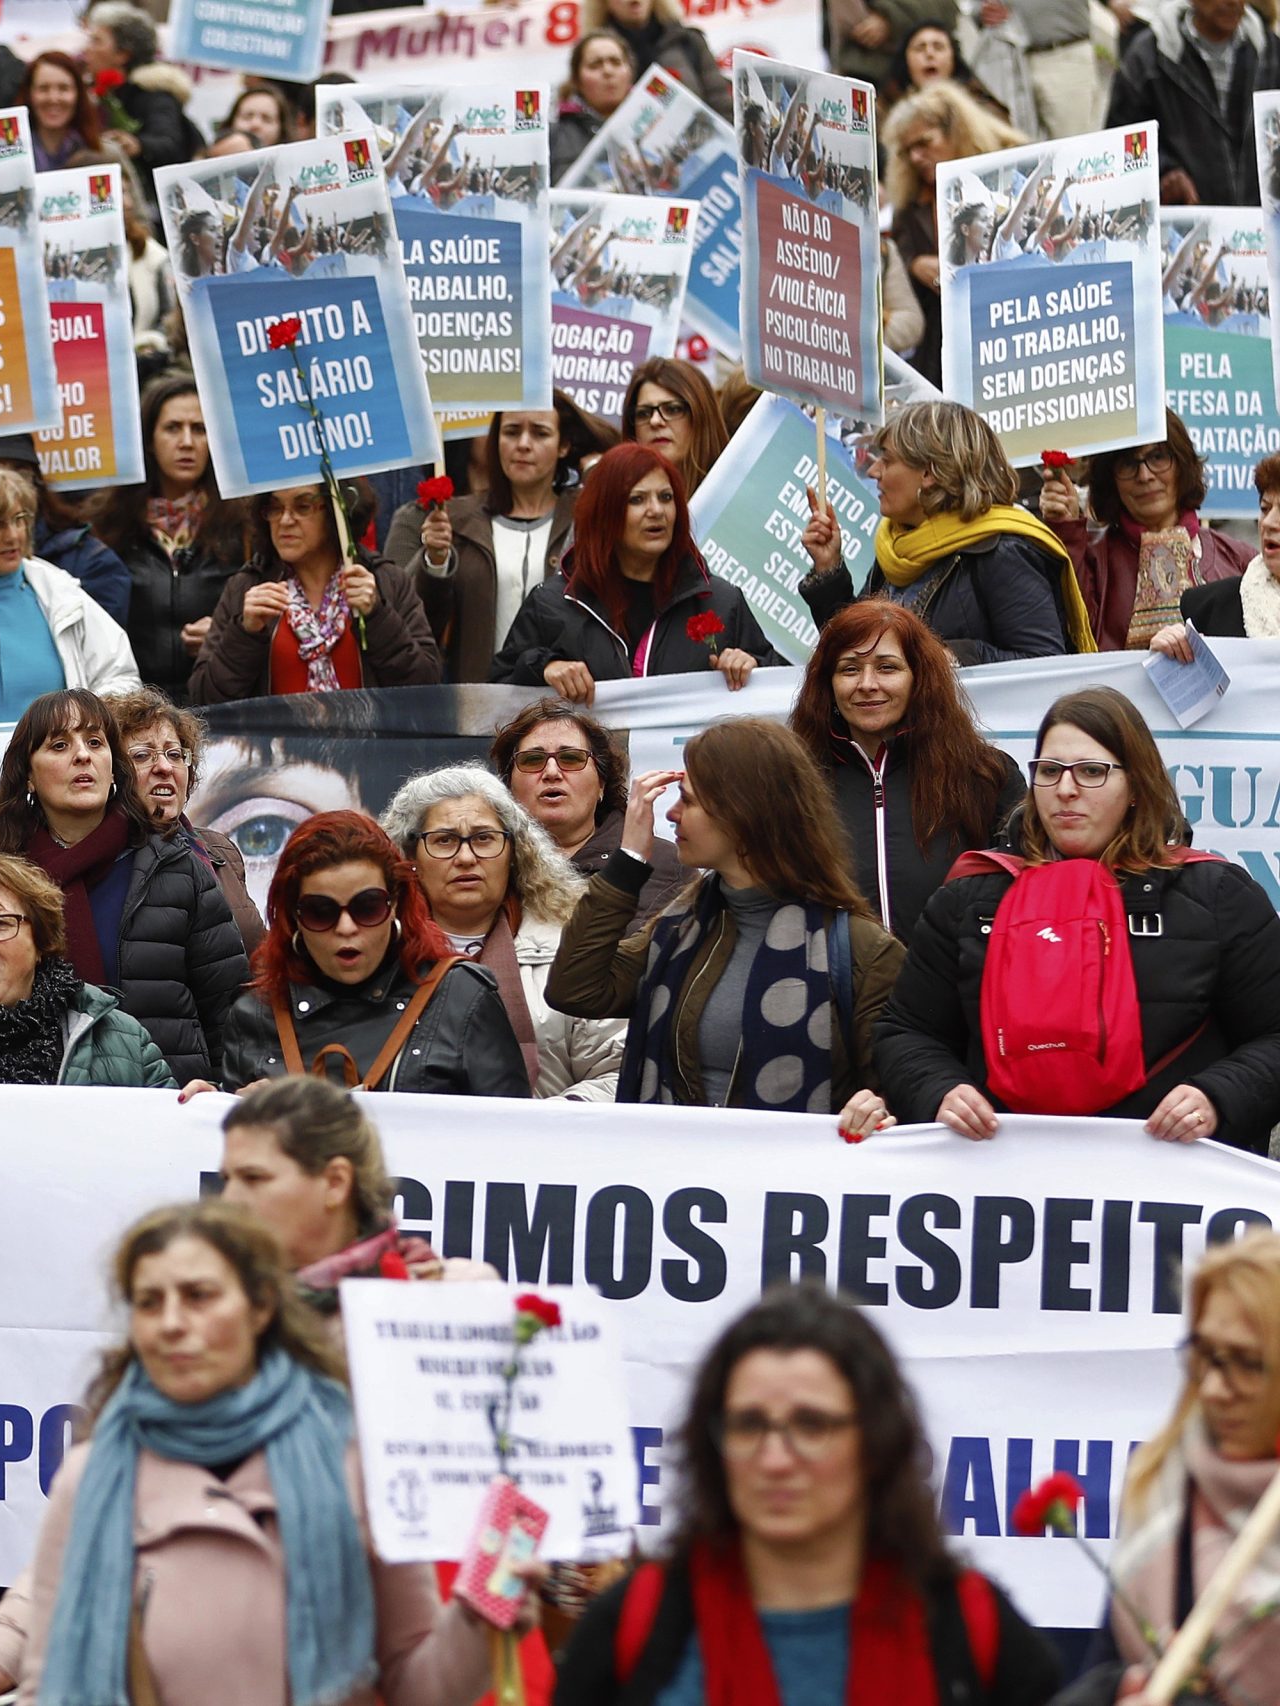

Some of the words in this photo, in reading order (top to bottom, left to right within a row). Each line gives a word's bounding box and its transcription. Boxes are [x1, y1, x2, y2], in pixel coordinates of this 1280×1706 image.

[353, 13, 530, 70] Mulher
[545, 1, 580, 44] 8
[781, 203, 809, 236] NÃO
[813, 214, 832, 241] AO
[430, 235, 501, 265] SAÚDE
[407, 275, 513, 303] RABALHO,
[990, 295, 1041, 328] PELA
[1046, 280, 1113, 317] SAÚDE
[51, 315, 99, 343] GUAL
[351, 300, 372, 336] A
[765, 308, 852, 358] PSICOLÓGICA
[979, 337, 1007, 366] NO
[1012, 315, 1126, 359] TRABALHO,
[256, 355, 374, 409] SALÁRIO
[764, 344, 783, 374] NO
[787, 350, 856, 396] TRABALHO
[982, 369, 1025, 401] SEM
[1030, 350, 1126, 391] DOENÇAS
[1180, 352, 1232, 379] PELA
[1165, 389, 1230, 417] EFESA
[1235, 390, 1263, 416] DA
[278, 411, 373, 460] DIGNO!
[860, 512, 879, 536] A
[1027, 1042, 1066, 1051] Quechua
